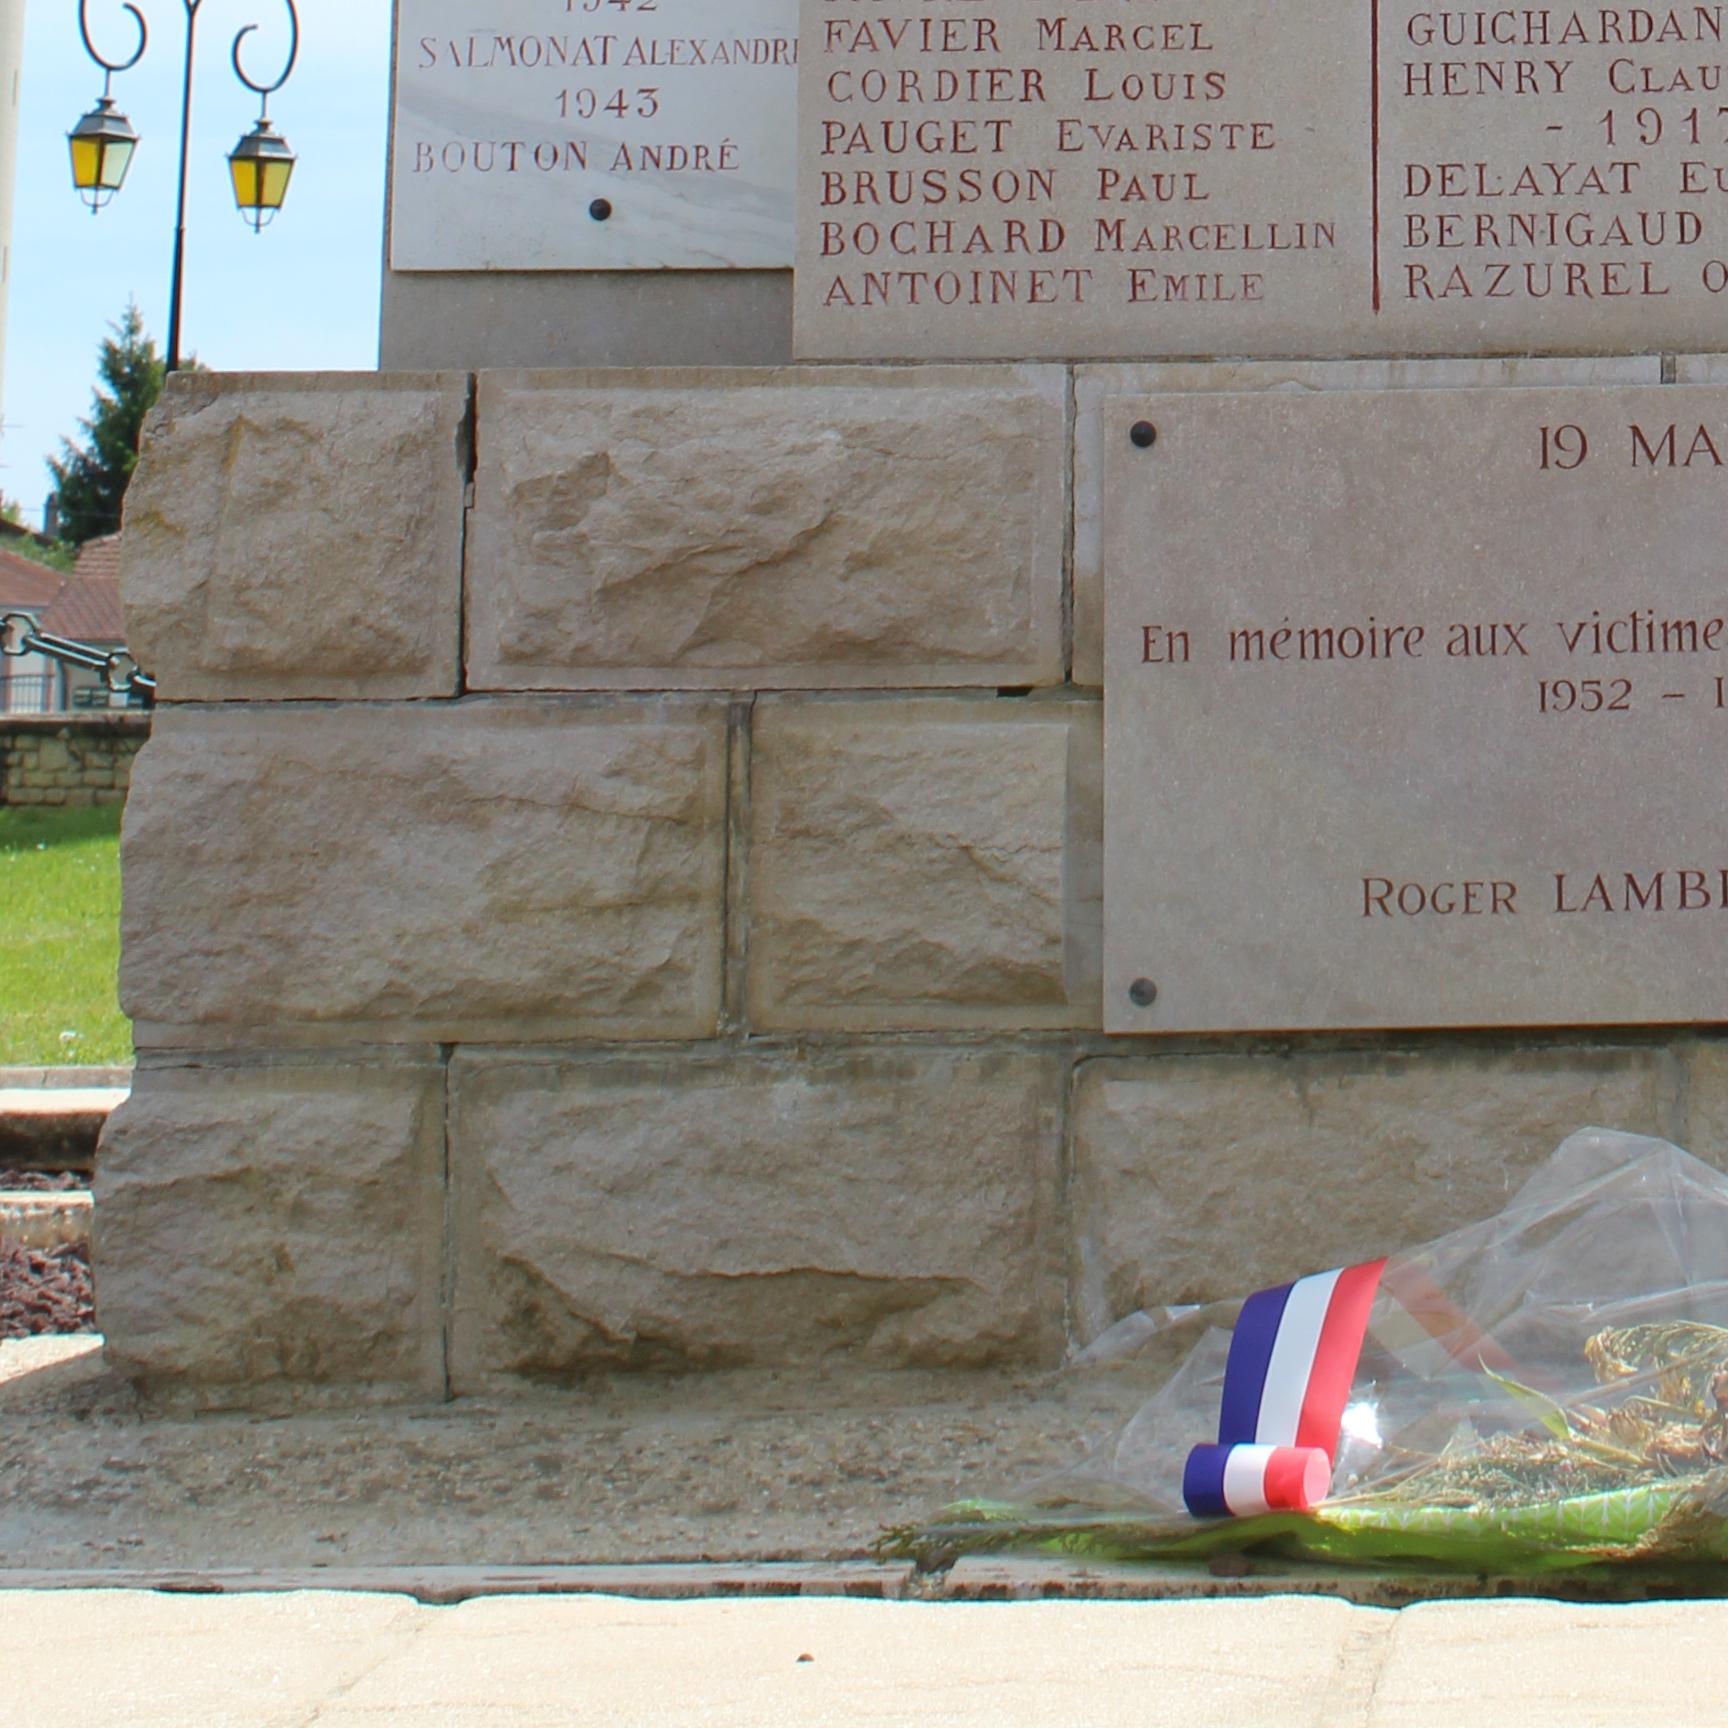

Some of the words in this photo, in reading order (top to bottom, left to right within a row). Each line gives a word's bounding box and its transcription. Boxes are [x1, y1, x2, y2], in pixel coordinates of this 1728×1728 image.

[825, 18, 1000, 53] FAVIER
[1407, 7, 1721, 46] GUICHARDAN
[828, 68, 1045, 102] CORDIER
[1404, 60, 1572, 96] HENRY
[557, 88, 658, 118] 1943
[821, 120, 1012, 155] PAUGET
[414, 141, 587, 172] BOUTON
[821, 169, 1055, 206] BRUSSON
[1405, 162, 1640, 197] DELAYAT
[821, 219, 1065, 256] BOCHARD
[1404, 211, 1702, 247] BERNIGAUD
[823, 269, 1092, 306] ANTOINET
[1404, 262, 1669, 300] RAZUREL
[1540, 425, 1587, 469] 19
[1142, 626, 1189, 663] En
[1230, 617, 1424, 661] mémoire
[1447, 624, 1528, 656] aux
[1539, 679, 1632, 713] 1952
